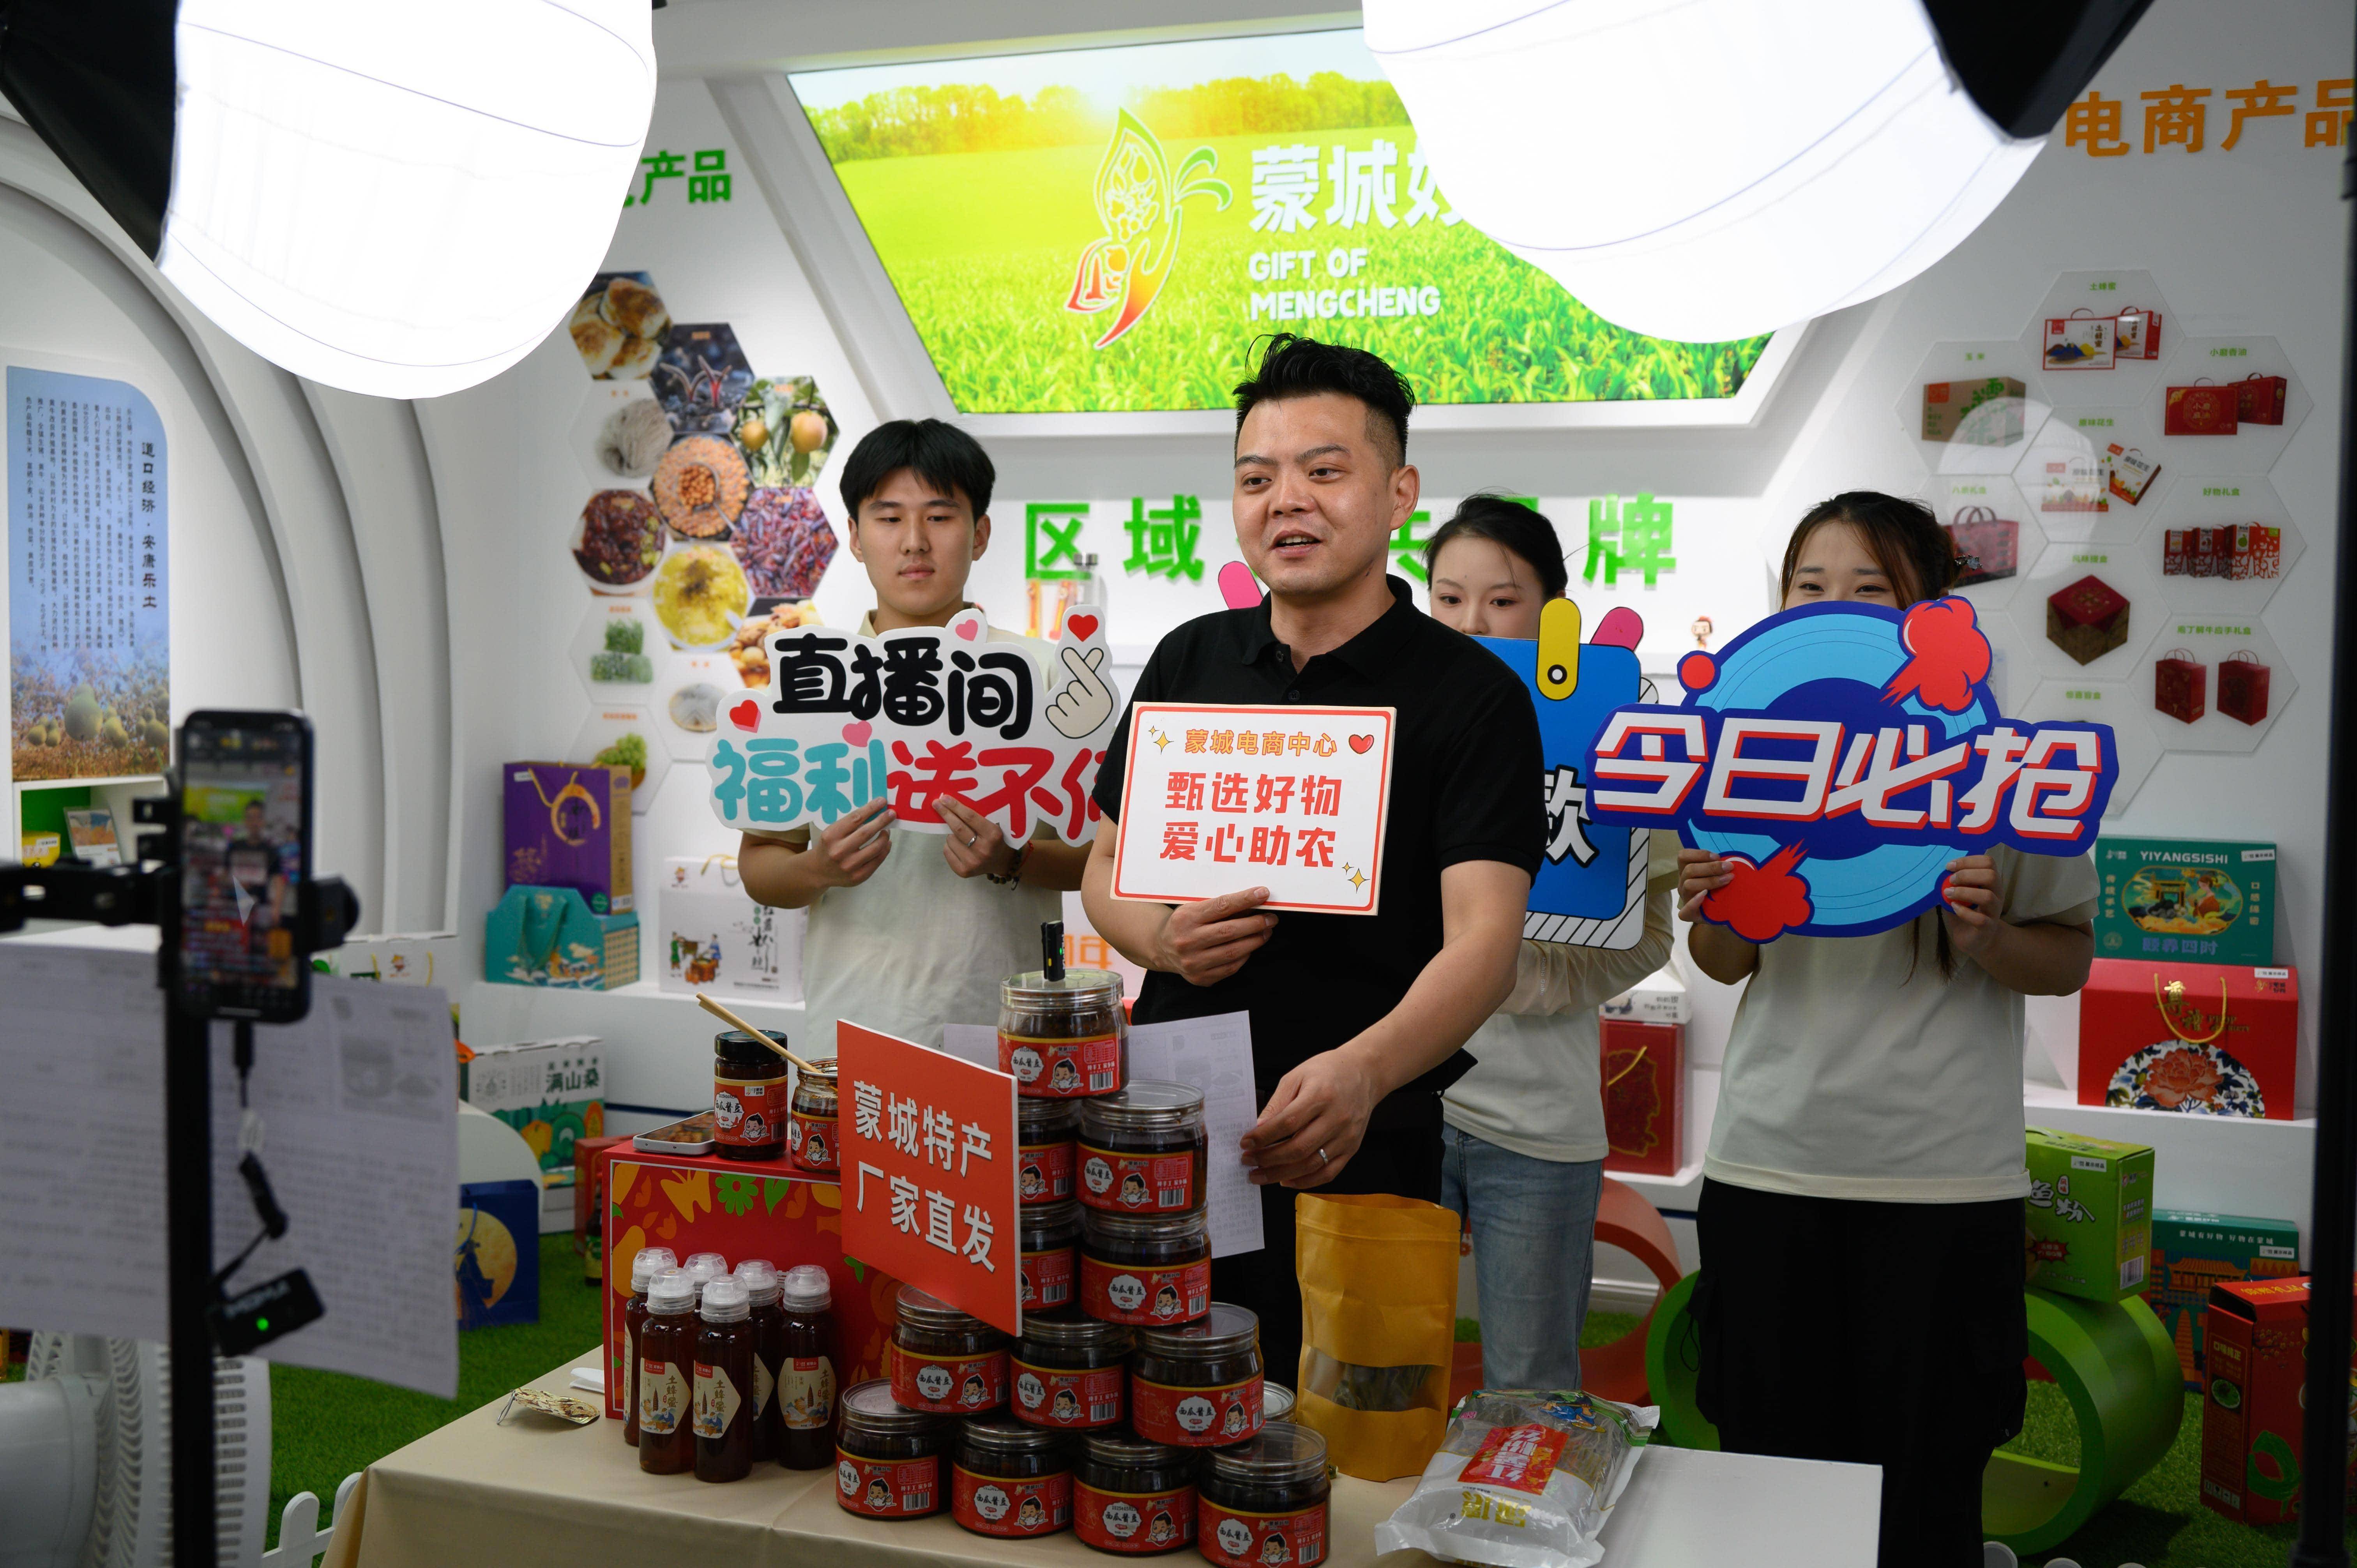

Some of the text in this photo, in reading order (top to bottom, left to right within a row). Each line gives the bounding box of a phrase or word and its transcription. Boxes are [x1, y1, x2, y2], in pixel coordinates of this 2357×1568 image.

[2065, 78, 2355, 157] 电商产品
[624, 149, 732, 207] 产品
[1249, 247, 1368, 281] GIFT OF
[1250, 286, 1441, 321] MENGCHENG
[772, 633, 1034, 741] 直播间
[1184, 729, 1338, 758] 蒙城电商中心
[712, 737, 1106, 841] 福利送不
[1164, 771, 1343, 817] 甄选好物
[1593, 710, 2103, 842] 今日必抢
[1159, 821, 1336, 868] 爱心助农
[2140, 850, 2228, 864] YIYANGSISHI
[853, 1080, 993, 1178] 蒙城特产
[857, 1160, 996, 1273] 厂家直发
[666, 1375, 678, 1408] 土蜂蜜
[714, 1379, 726, 1413] 土蜂蜜
